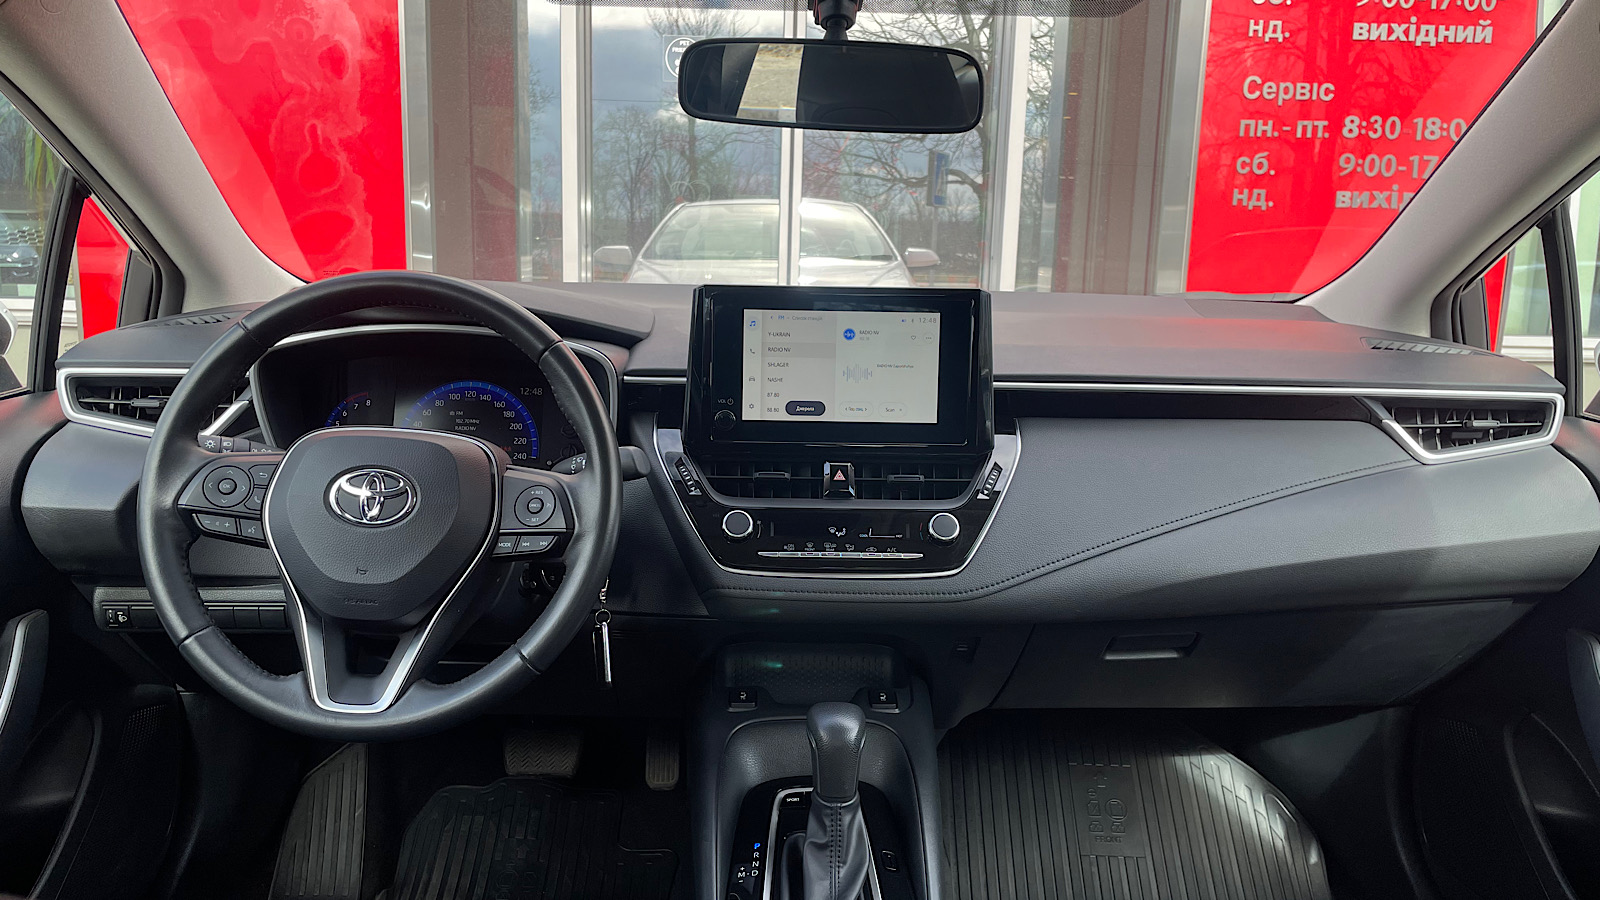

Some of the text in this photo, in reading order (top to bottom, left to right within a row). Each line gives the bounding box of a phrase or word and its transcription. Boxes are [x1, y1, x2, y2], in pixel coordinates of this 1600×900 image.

[1248, 16, 1493, 47] нд. вихідний
[1243, 75, 1335, 106] Сервіс
[1236, 151, 1276, 176] сб.
[1231, 188, 1275, 211] нд.
[465, 390, 477, 398] 120
[520, 387, 543, 396] 12:48
[434, 399, 445, 407] 80
[502, 410, 515, 418] 180
[509, 422, 523, 430] 200
[513, 437, 527, 445] 220
[513, 452, 527, 460] 240
